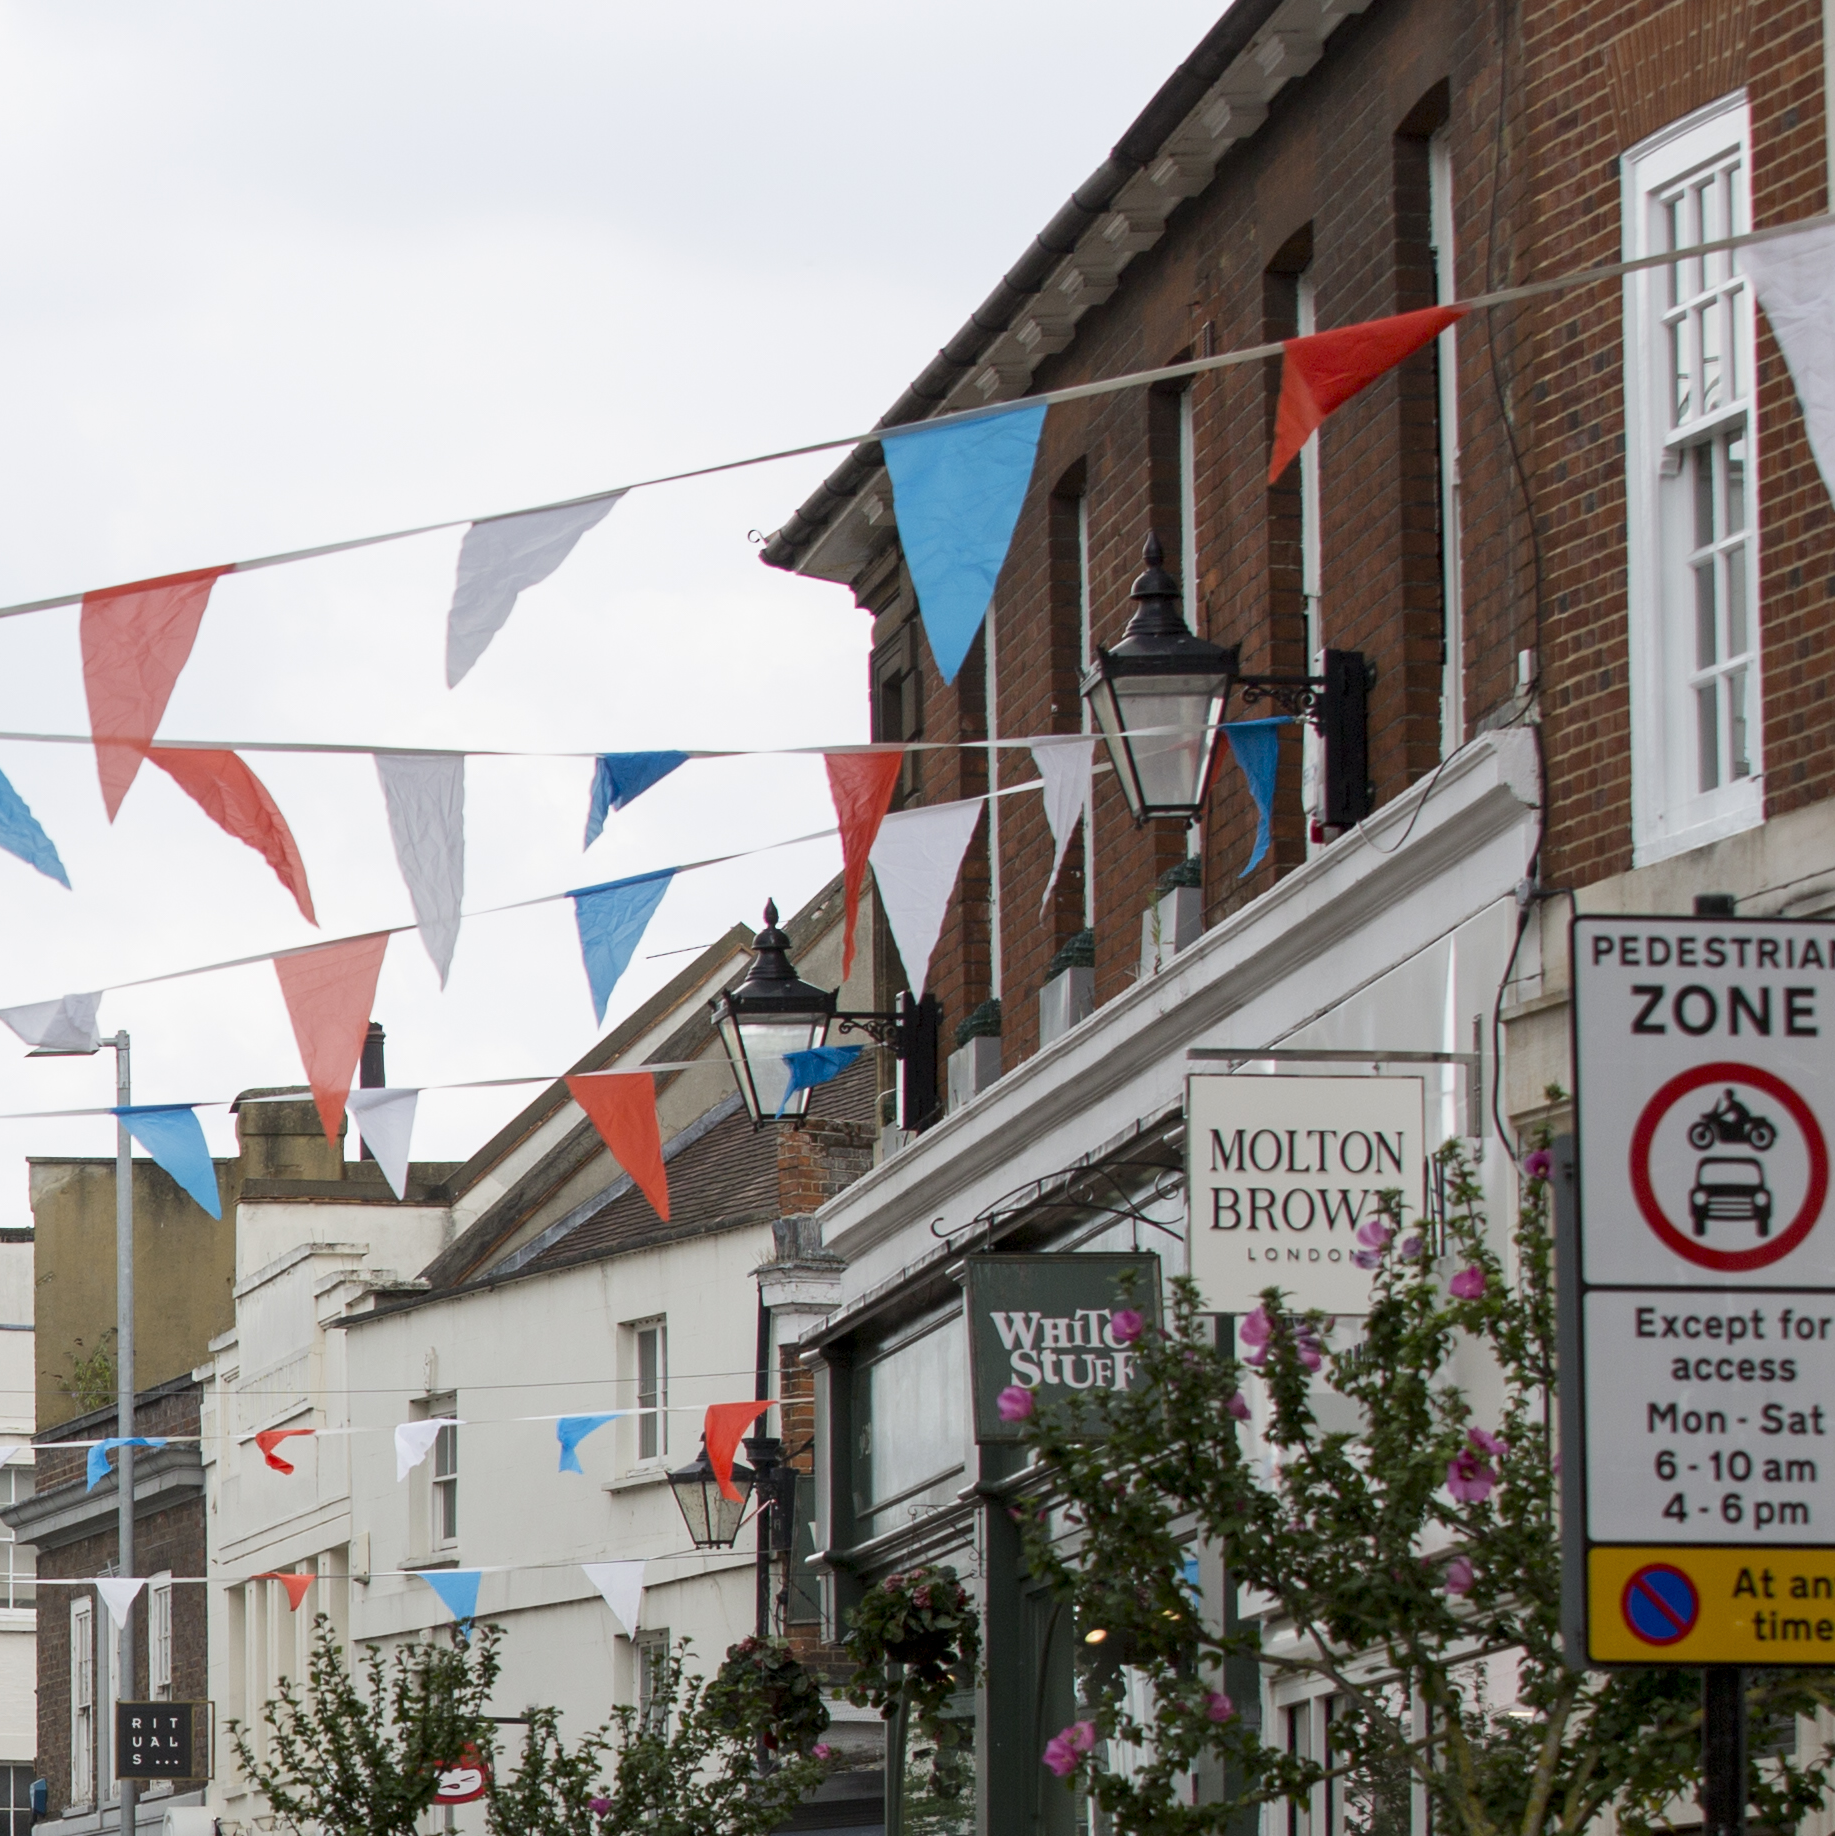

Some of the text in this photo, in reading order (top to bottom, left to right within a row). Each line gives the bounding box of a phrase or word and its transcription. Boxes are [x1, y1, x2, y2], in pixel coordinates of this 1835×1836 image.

[1630, 984, 1818, 1037] ZONE
[1209, 1129, 1405, 1174] MOLTON
[1247, 1247, 1358, 1262] LONDO
[1634, 1307, 1832, 1345] Except for
[1670, 1356, 1797, 1382] access
[1646, 1402, 1727, 1434] Mon
[1758, 1403, 1825, 1435] Sat
[1654, 1450, 1677, 1482] 6
[1708, 1450, 1752, 1482] 10
[1761, 1457, 1817, 1483] am
[1661, 1492, 1688, 1524] 4
[1719, 1493, 1743, 1525] 6
[1753, 1501, 1809, 1531] pm
[1732, 1567, 1835, 1600] At an
[1751, 1611, 1834, 1642] time
